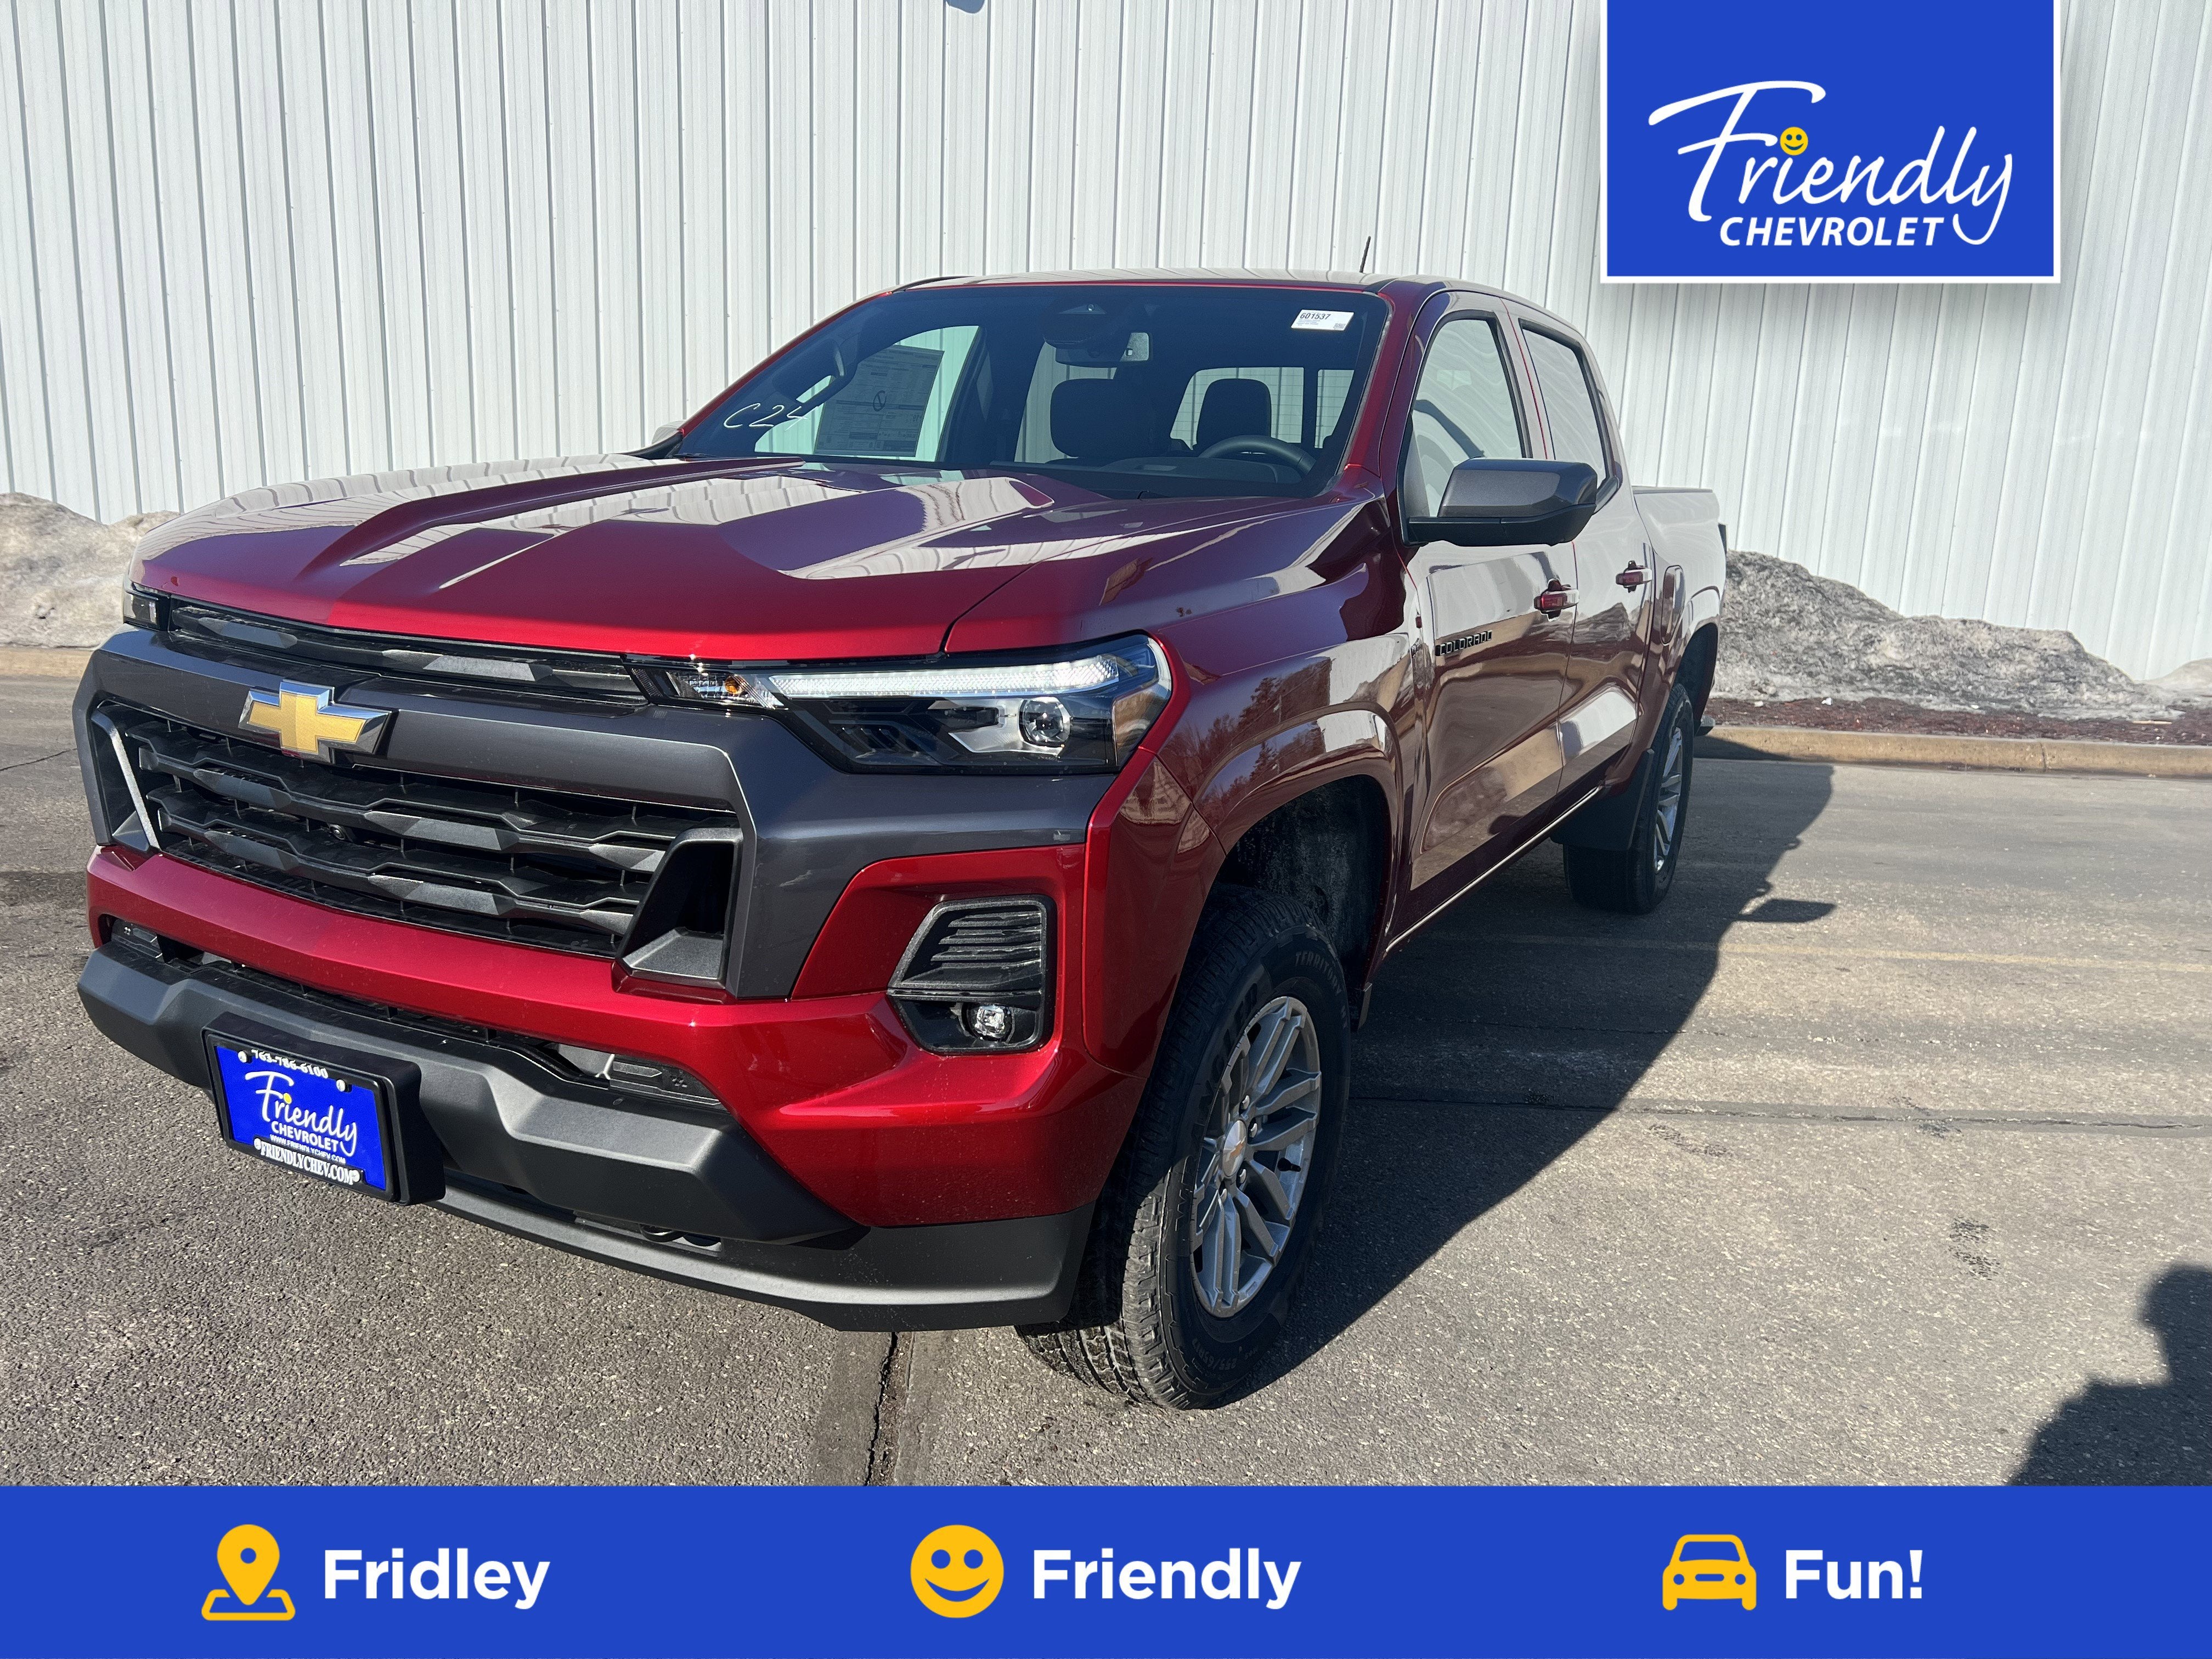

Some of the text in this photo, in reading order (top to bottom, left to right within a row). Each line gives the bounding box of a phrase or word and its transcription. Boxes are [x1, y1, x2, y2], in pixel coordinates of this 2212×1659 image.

[1440, 630, 1493, 656] COLORADO
[251, 1049, 329, 1079] 763-786-6100
[245, 1071, 358, 1157] Friendly
[271, 1121, 339, 1153] CHEVROLET
[260, 1141, 355, 1186] FRIENDLYCHEV.COM
